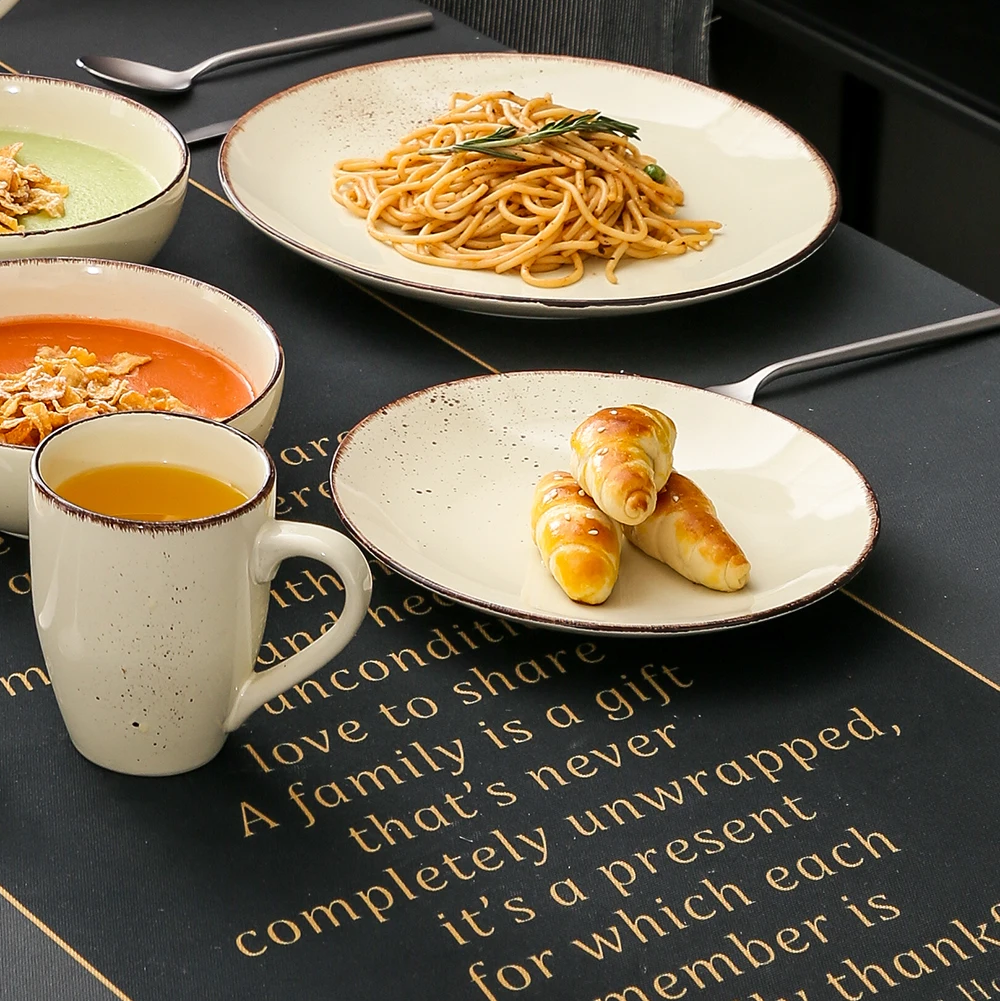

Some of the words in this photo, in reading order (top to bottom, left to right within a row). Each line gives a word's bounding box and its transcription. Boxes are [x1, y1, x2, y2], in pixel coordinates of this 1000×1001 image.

[270, 570, 344, 609] ith
[243, 720, 368, 773] love
[380, 697, 438, 726] to
[454, 641, 606, 705] share
[264, 616, 519, 715] unconditi
[241, 802, 278, 837] A
[288, 739, 464, 826] family
[480, 720, 532, 749] is
[546, 704, 580, 728] a
[596, 662, 693, 720] gift
[349, 781, 516, 853] that's
[528, 721, 678, 791] never
[236, 826, 547, 956] completely
[566, 707, 902, 837] unwrapped,
[438, 895, 535, 945] it's
[550, 878, 586, 906] a
[600, 795, 816, 896] present
[469, 949, 552, 1000] for
[573, 878, 751, 960] which
[766, 826, 898, 891] each
[827, 903, 1000, 1000] thank
[842, 894, 900, 927] is
